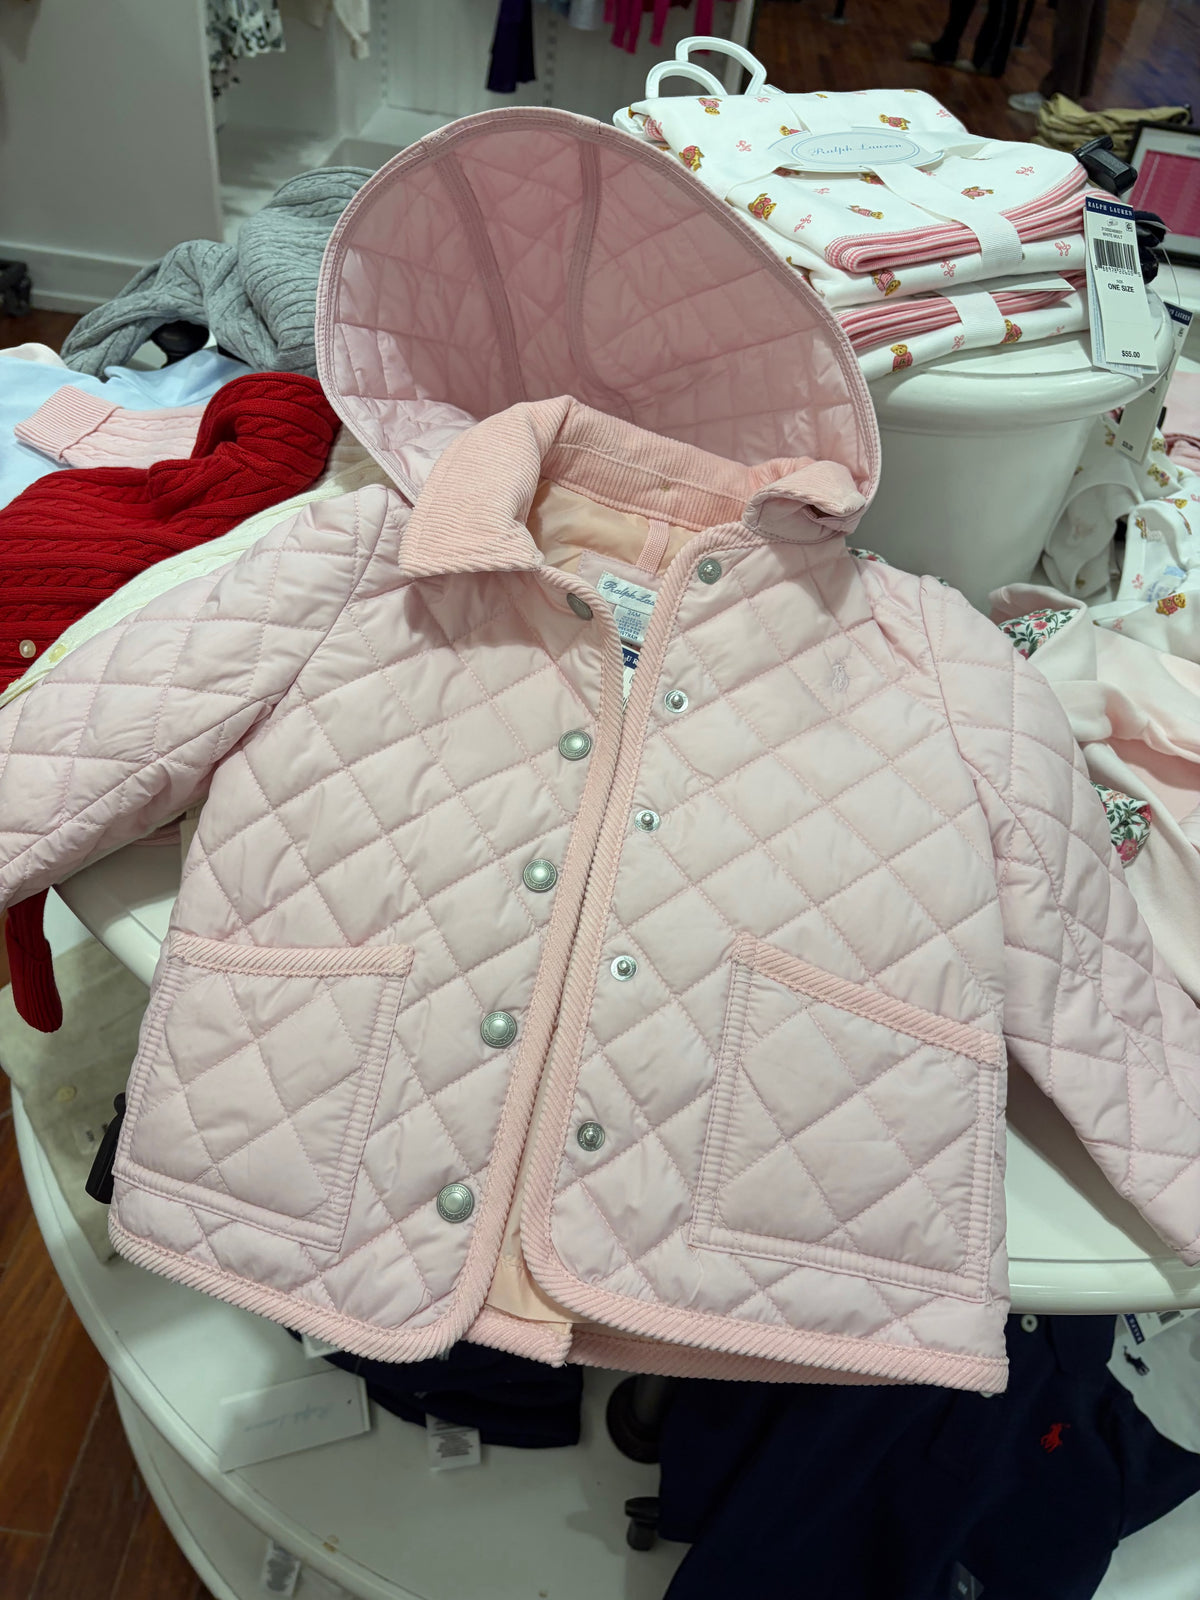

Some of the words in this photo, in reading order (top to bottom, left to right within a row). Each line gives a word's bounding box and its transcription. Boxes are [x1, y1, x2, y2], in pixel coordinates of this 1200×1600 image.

[1087, 201, 1107, 211] RALPH
[1109, 206, 1133, 216] LAUREN
[1108, 283, 1120, 291] ONE
[1121, 285, 1135, 293] SIZE
[1121, 350, 1141, 358] $55.00
[602, 580, 636, 599] Ralph
[636, 592, 655, 606] Lau
